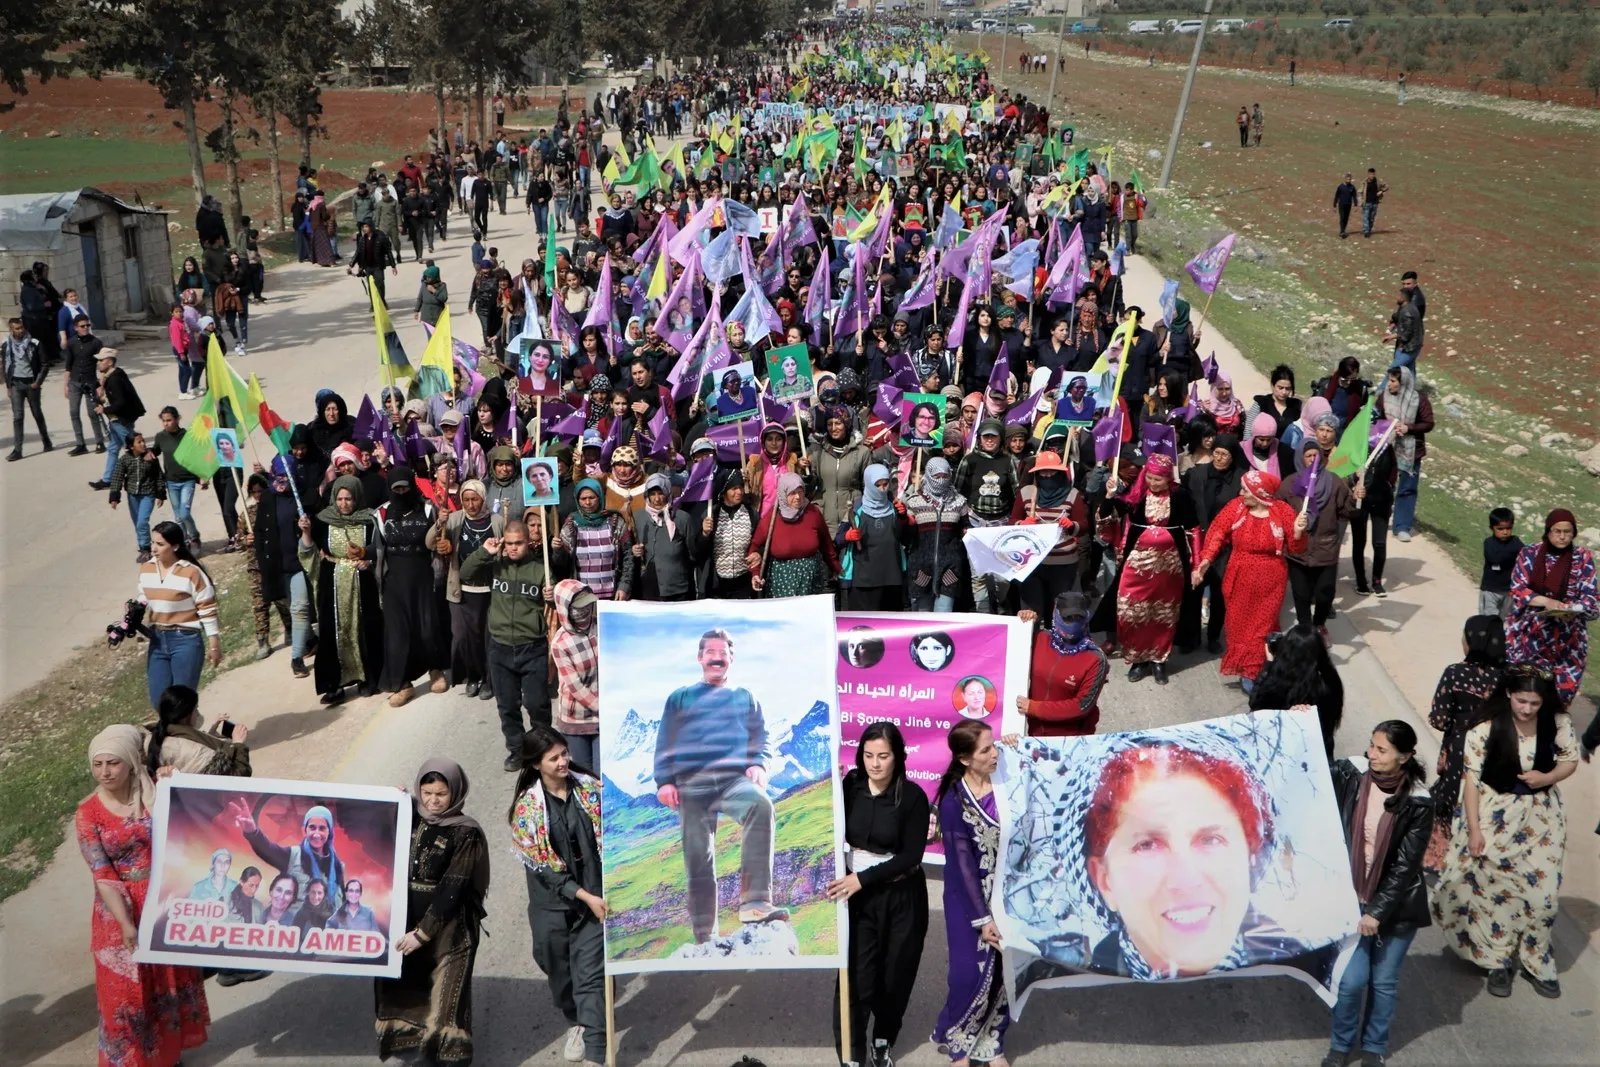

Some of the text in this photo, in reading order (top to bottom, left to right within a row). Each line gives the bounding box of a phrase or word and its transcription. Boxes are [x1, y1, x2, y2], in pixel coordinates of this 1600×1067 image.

[762, 211, 772, 228] I
[857, 683, 895, 699] الحياة
[899, 683, 935, 702] المرأة
[841, 711, 853, 723] Bi
[906, 714, 932, 729] Jinê
[936, 721, 950, 731] ve
[173, 901, 225, 919] ŞEHÎD
[169, 923, 382, 954] RAPERÎN AMED
